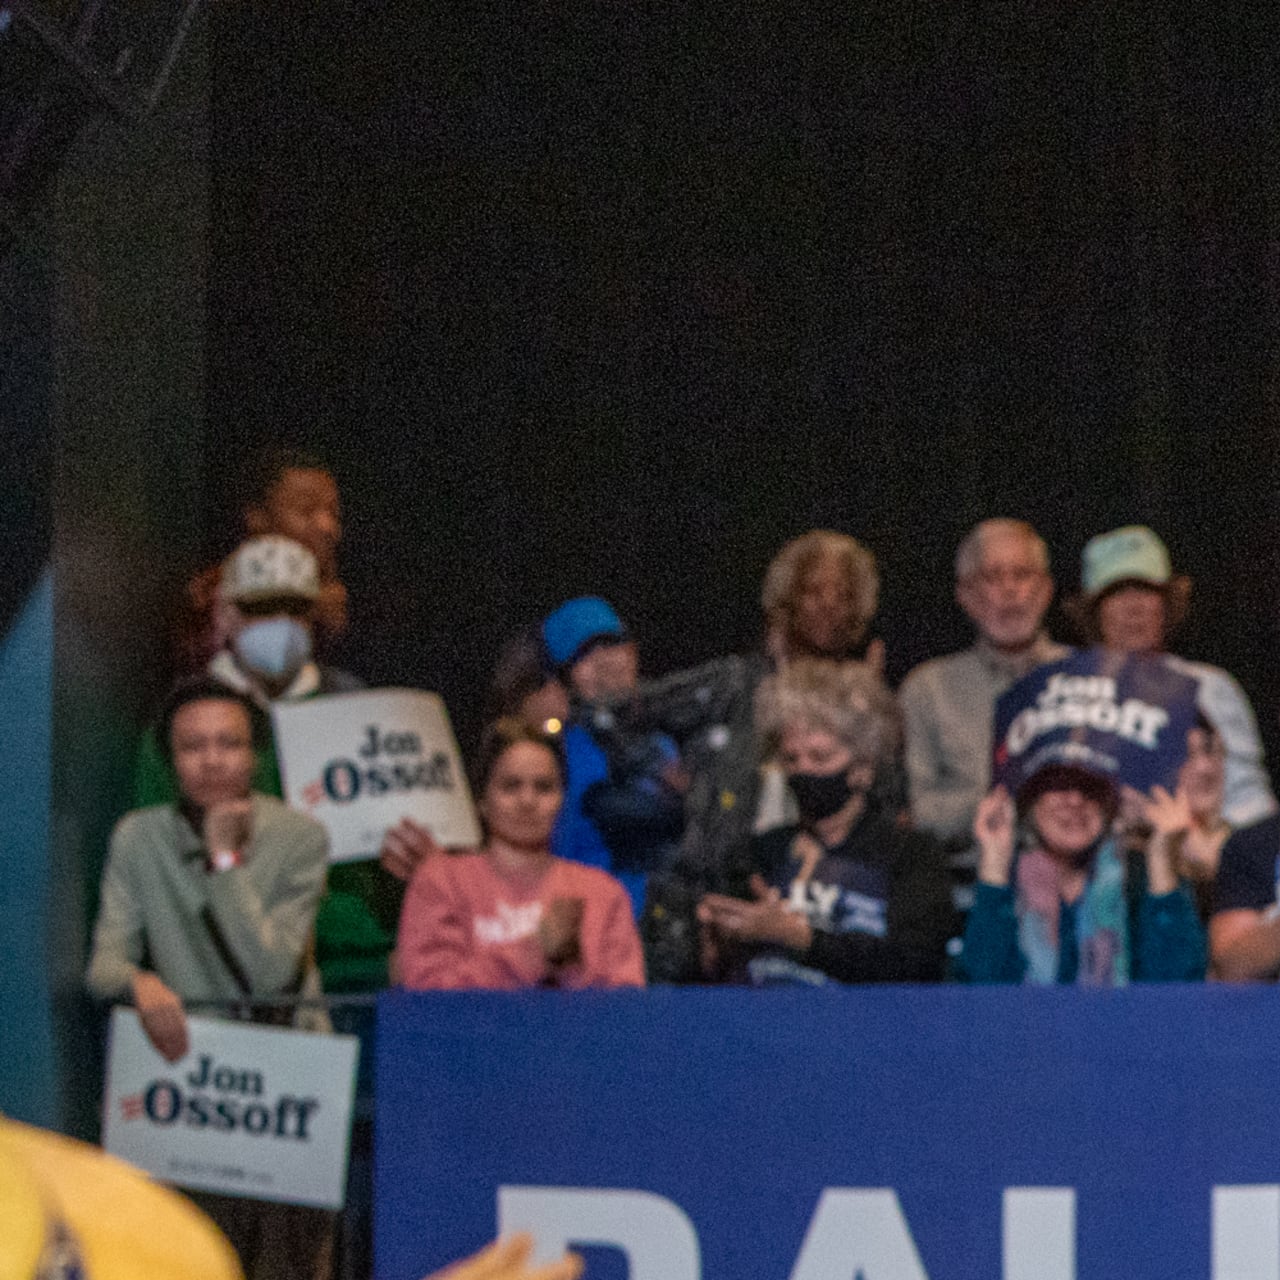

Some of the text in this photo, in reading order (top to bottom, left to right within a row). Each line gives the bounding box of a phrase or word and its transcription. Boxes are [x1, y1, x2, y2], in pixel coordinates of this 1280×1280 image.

[360, 724, 422, 759] Jon
[187, 1053, 264, 1096] Jon
[144, 1079, 318, 1140] Ossoff
